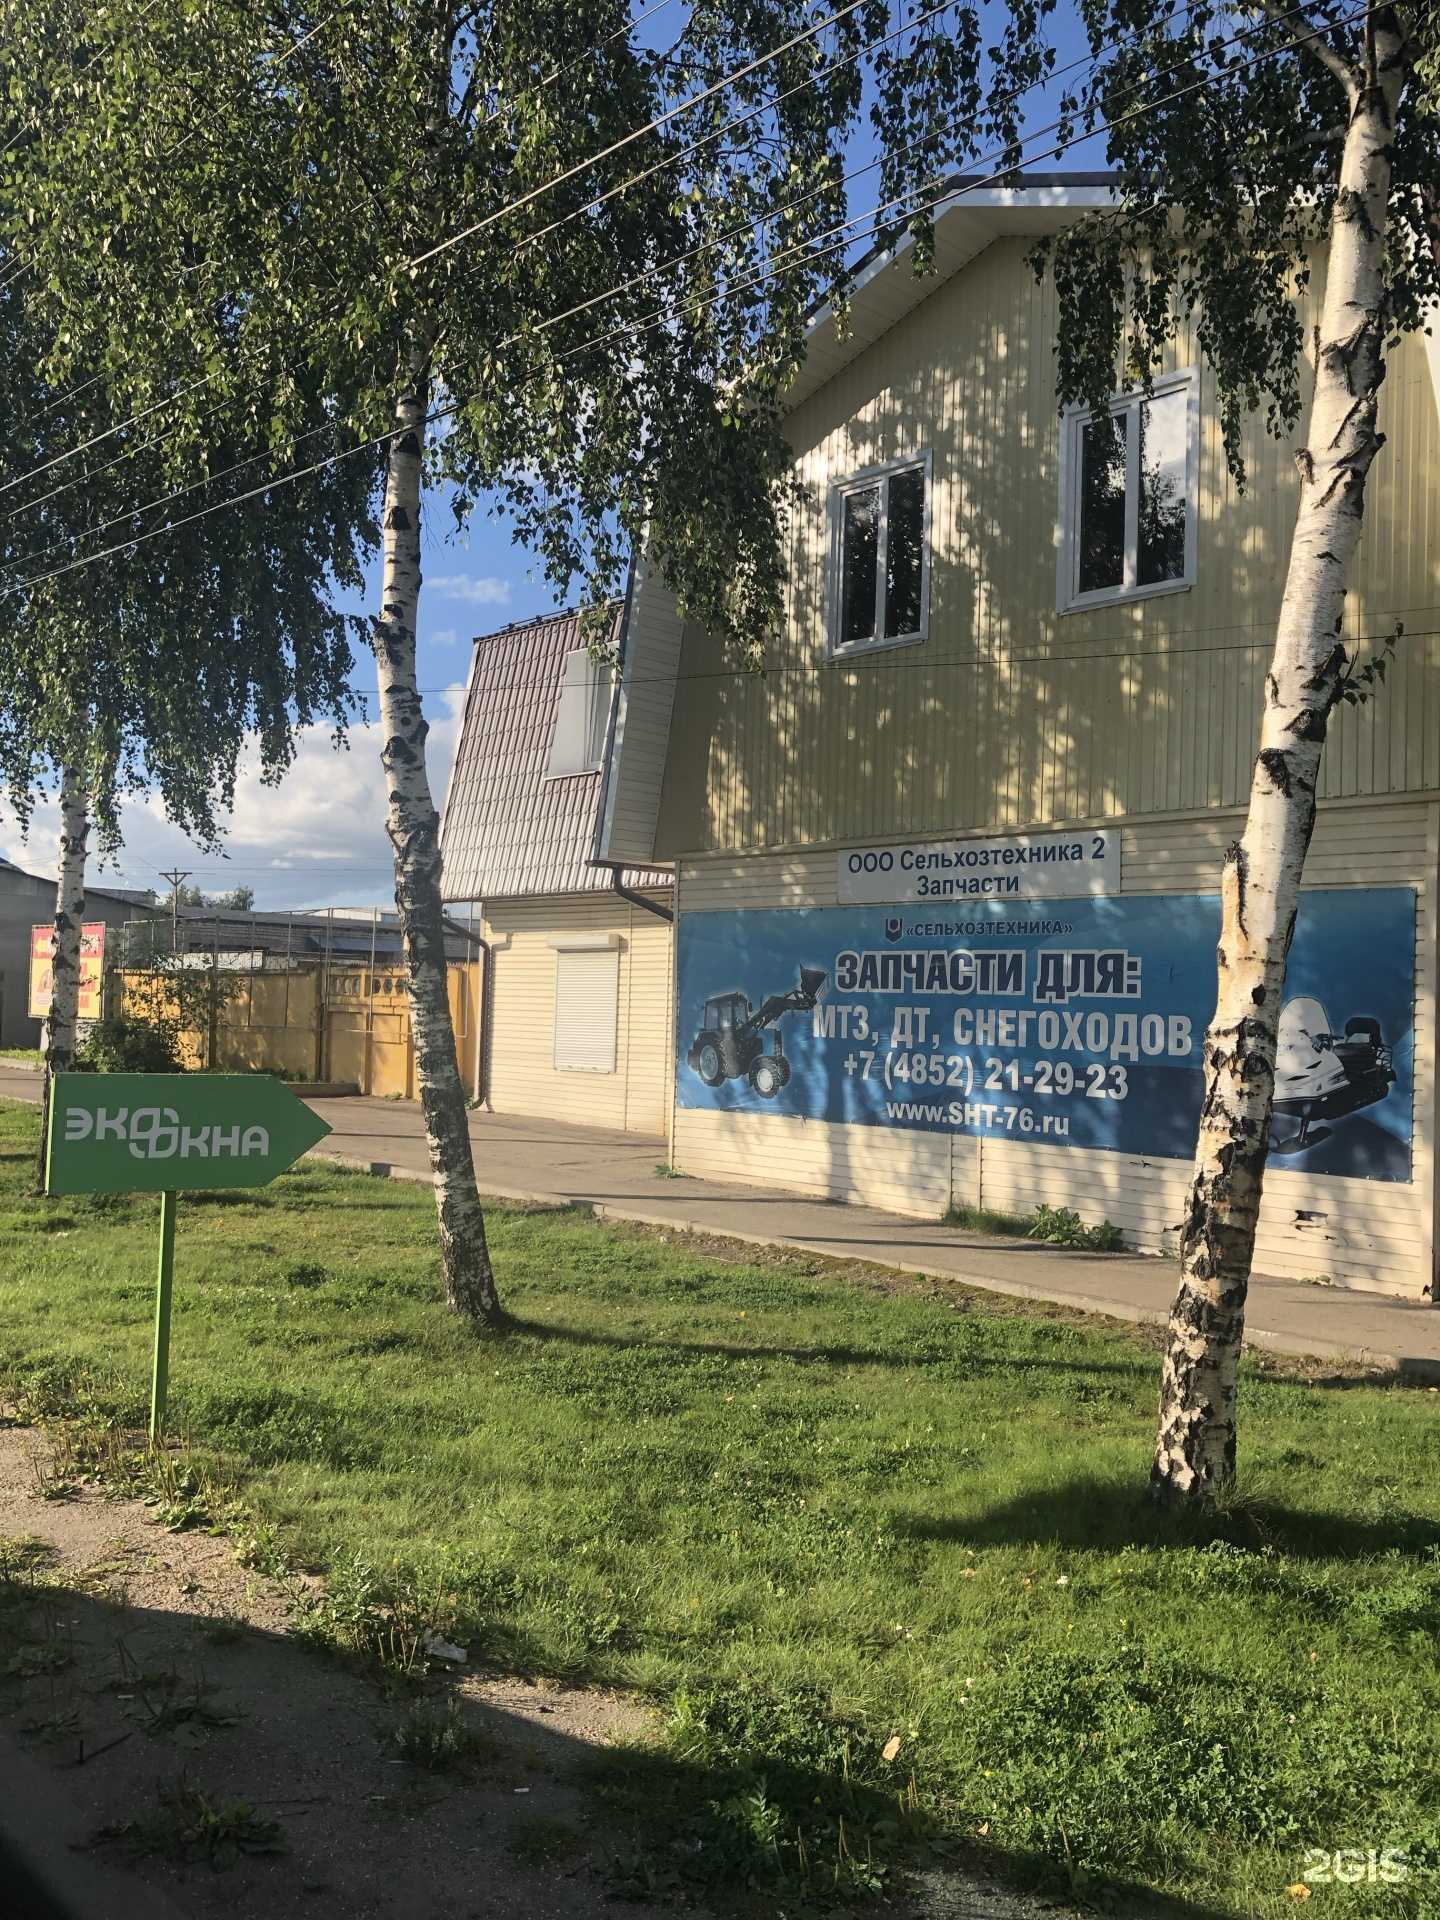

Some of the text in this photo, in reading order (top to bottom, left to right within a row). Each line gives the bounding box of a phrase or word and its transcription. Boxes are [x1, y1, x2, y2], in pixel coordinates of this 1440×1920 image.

[848, 836, 1106, 874] ООО Сельхозтехника 2
[917, 875, 1019, 896] Запчасти
[835, 949, 1142, 1004] ЗАПЧАСТИ ДЛЯ:
[813, 1004, 1193, 1062] МТЗ, ДТ, СНЕГОХОДОВ
[844, 1051, 1129, 1101] +7 (4852) 21-29-23
[886, 1101, 1070, 1136] www.SHT-76.ru
